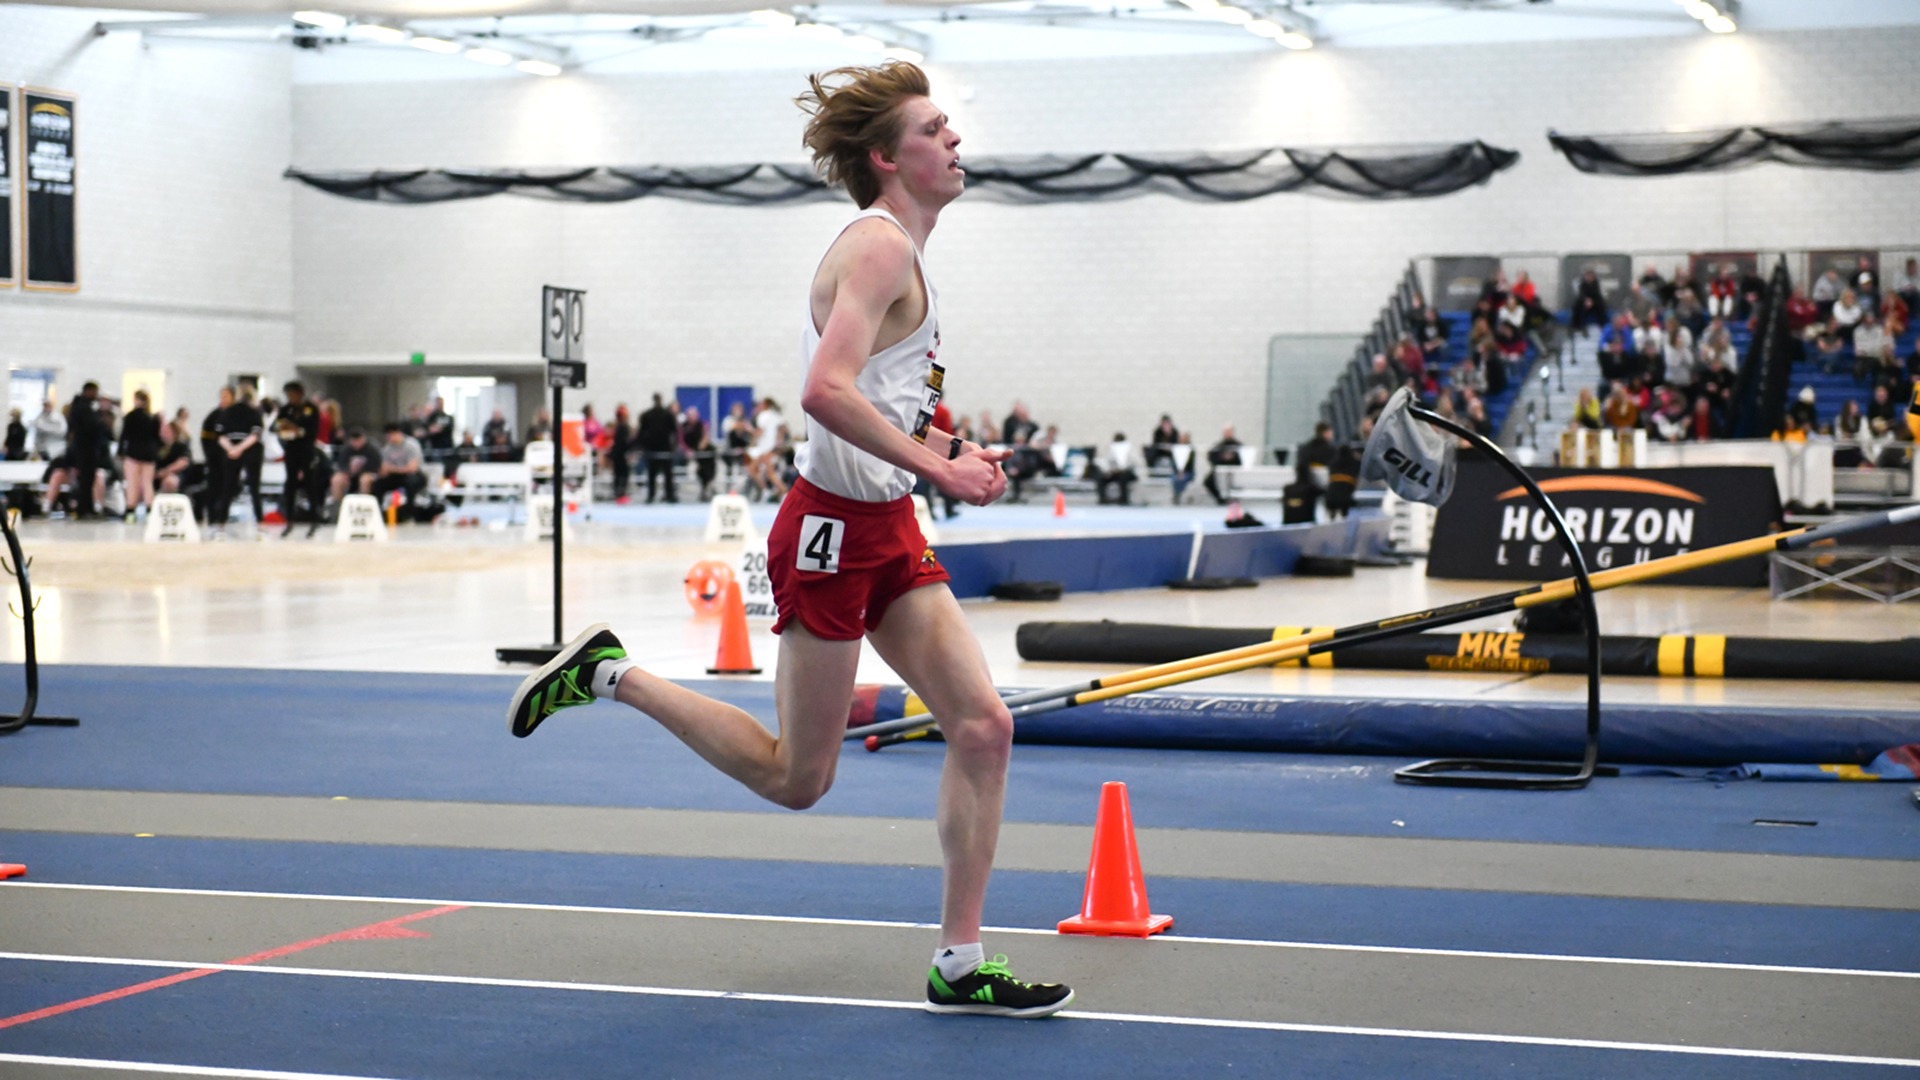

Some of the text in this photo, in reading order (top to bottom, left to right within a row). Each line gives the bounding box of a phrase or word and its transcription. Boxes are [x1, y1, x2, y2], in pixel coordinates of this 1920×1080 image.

[1383, 446, 1432, 489] GILL
[1501, 505, 1694, 545] HORIZON
[805, 521, 833, 570] 4
[747, 575, 769, 595] 66
[1457, 631, 1525, 659] MKE
[1213, 702, 1279, 713] POLES
